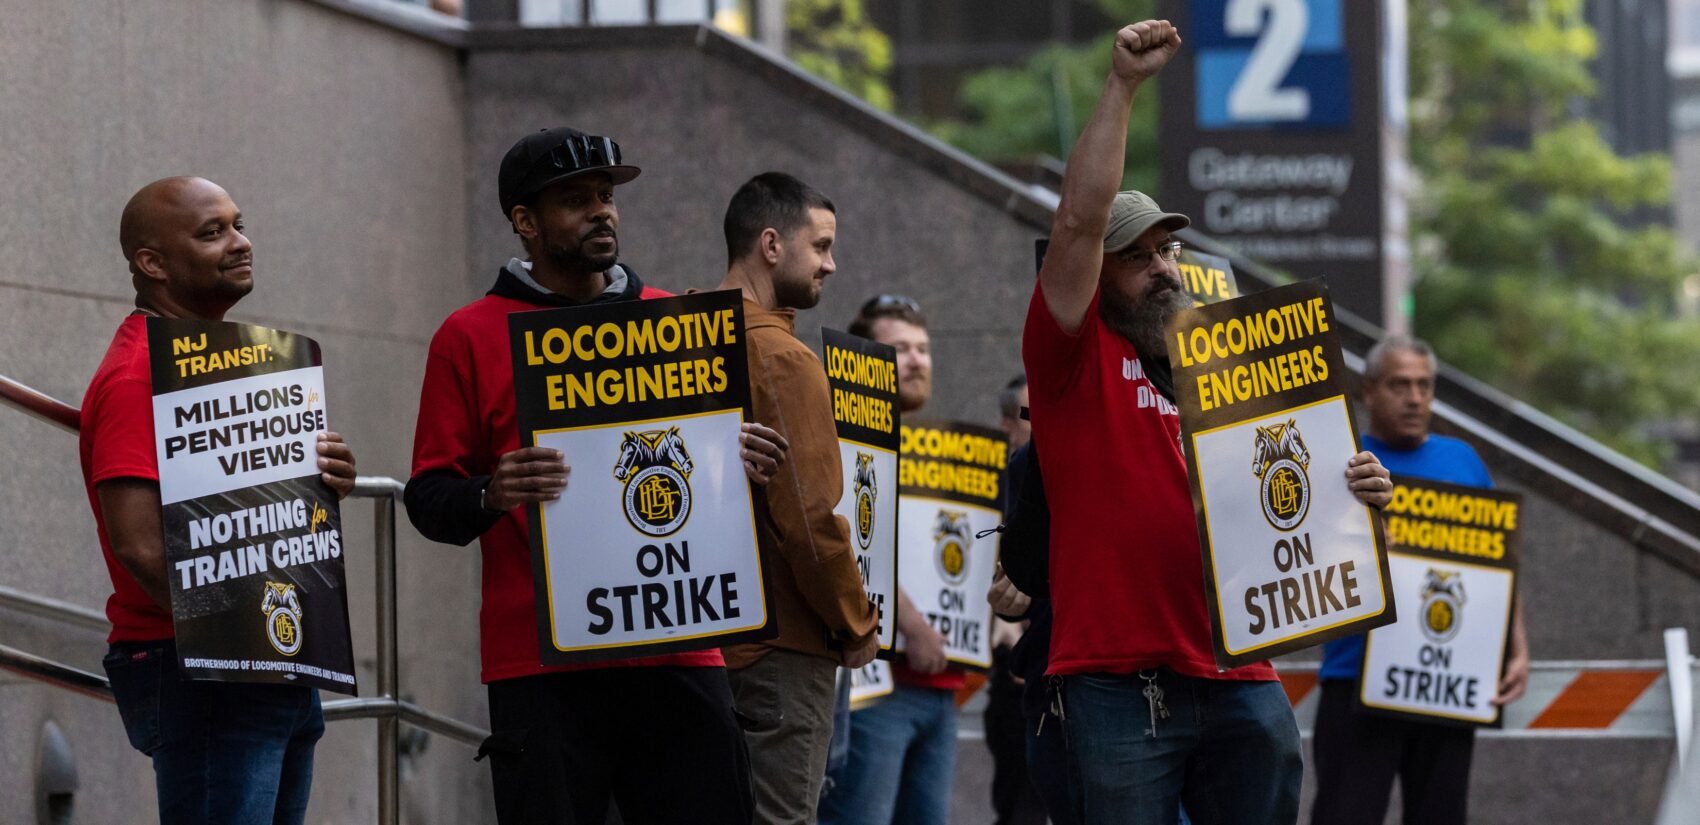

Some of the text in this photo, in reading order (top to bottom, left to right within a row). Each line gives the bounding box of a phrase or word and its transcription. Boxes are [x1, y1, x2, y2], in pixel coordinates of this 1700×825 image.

[1224, 0, 1311, 120] 2
[1189, 148, 1353, 197] Gateway
[1205, 191, 1339, 233] Center
[172, 333, 208, 356] NJ
[525, 309, 736, 366] LOCOMOTIVE
[1177, 297, 1329, 368] LOCOMOTIVE
[176, 344, 273, 378] TRANSIT:
[826, 345, 896, 393] LOCOMOTIVE
[1197, 346, 1329, 411] ENGINEERS
[174, 384, 303, 428] MILLIONS
[546, 357, 728, 411] ENGINEERS
[834, 388, 893, 434] ENGINEERS
[165, 409, 324, 460] PENTHOUSE
[900, 425, 1006, 470] OCOMOTIVE
[218, 441, 304, 476] VIEWS
[899, 458, 999, 500] ENGINEERS
[189, 499, 328, 550] NOTHING for
[1387, 516, 1505, 559] ENGINEERS
[175, 529, 340, 590] TRAIN CREWS
[636, 540, 691, 577] ON
[1274, 533, 1314, 573] ON
[586, 572, 740, 636] STRIKE
[938, 588, 965, 613] ON
[1244, 560, 1362, 635] STRIKE
[927, 613, 980, 655] TRIKE
[184, 658, 355, 685] BROTHERHOOD OF LOCOMOTIVE ENGINEERS AND TRAINMEN
[1419, 646, 1452, 670] ON
[1384, 666, 1479, 708] STRIKE
